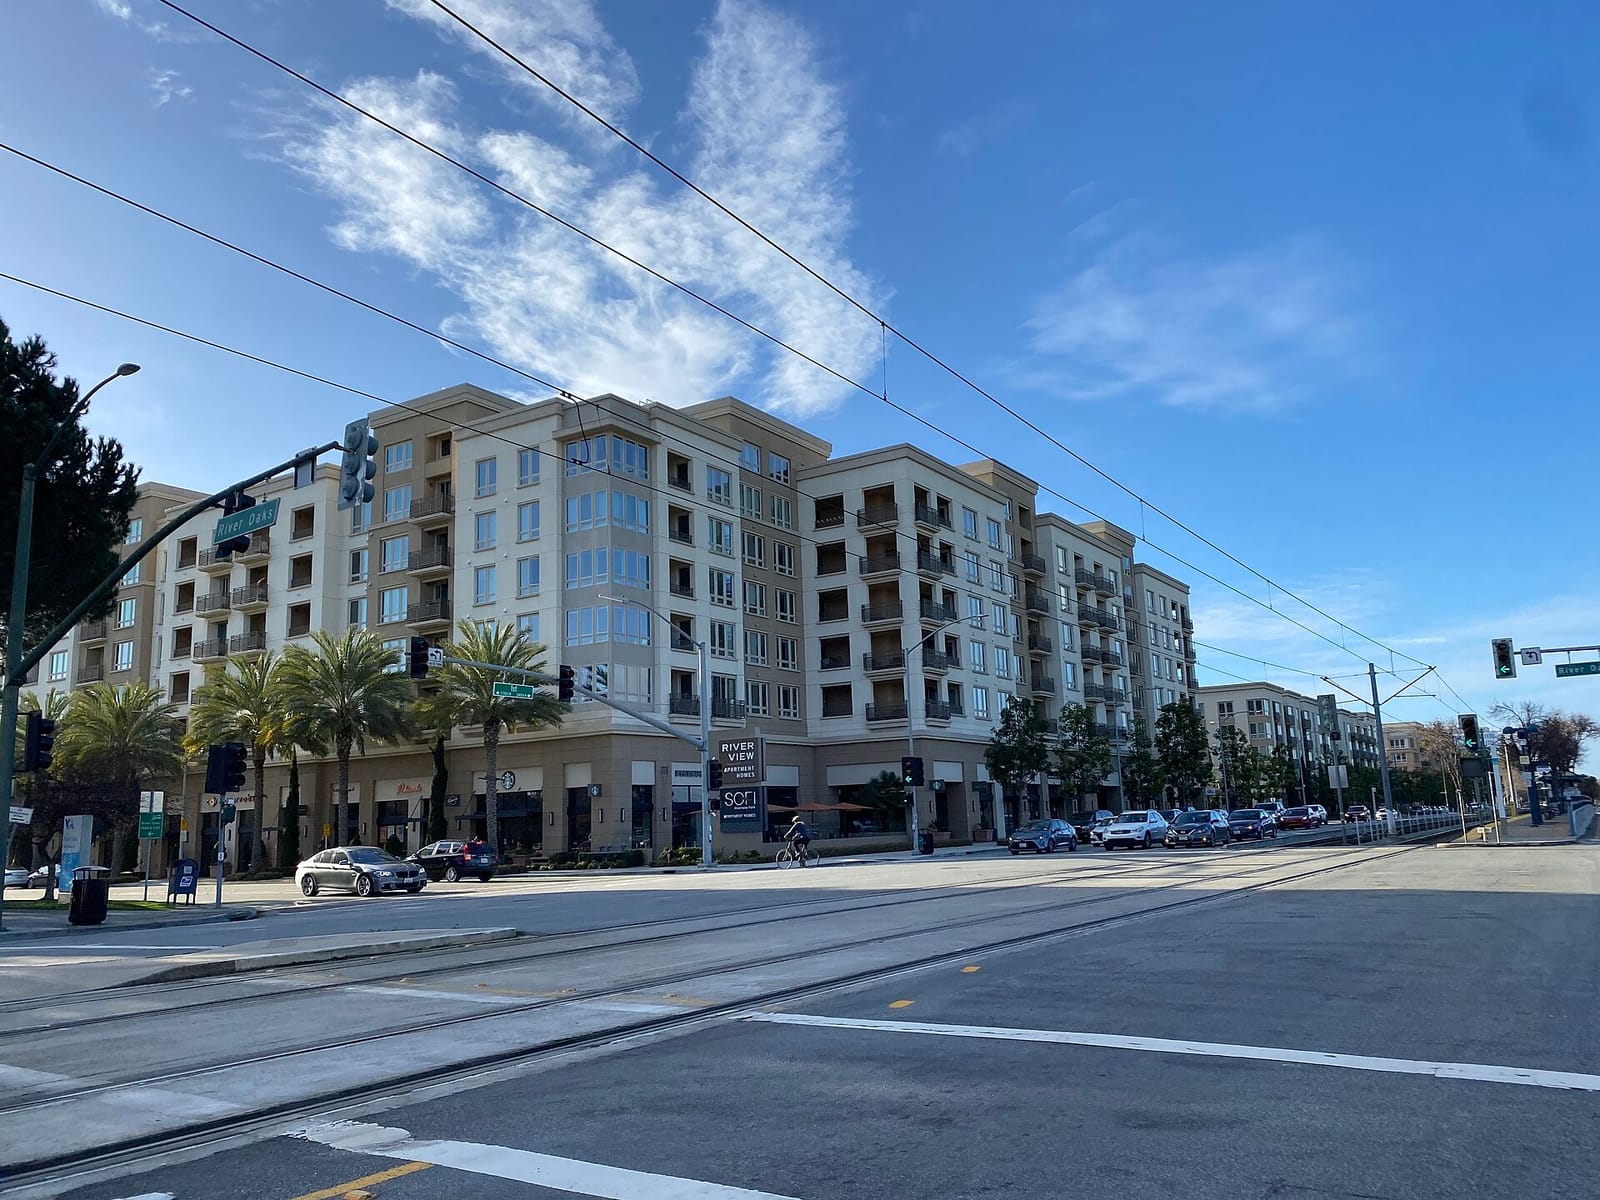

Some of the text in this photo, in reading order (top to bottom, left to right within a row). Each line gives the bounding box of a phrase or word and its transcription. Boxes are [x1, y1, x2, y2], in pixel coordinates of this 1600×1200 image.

[217, 508, 273, 537] River Oaks
[1559, 666, 1585, 675] River
[721, 741, 754, 752] RIVER
[728, 751, 754, 761] VIEW
[723, 765, 755, 773] APARTMENT
[724, 791, 756, 807] SOFI
